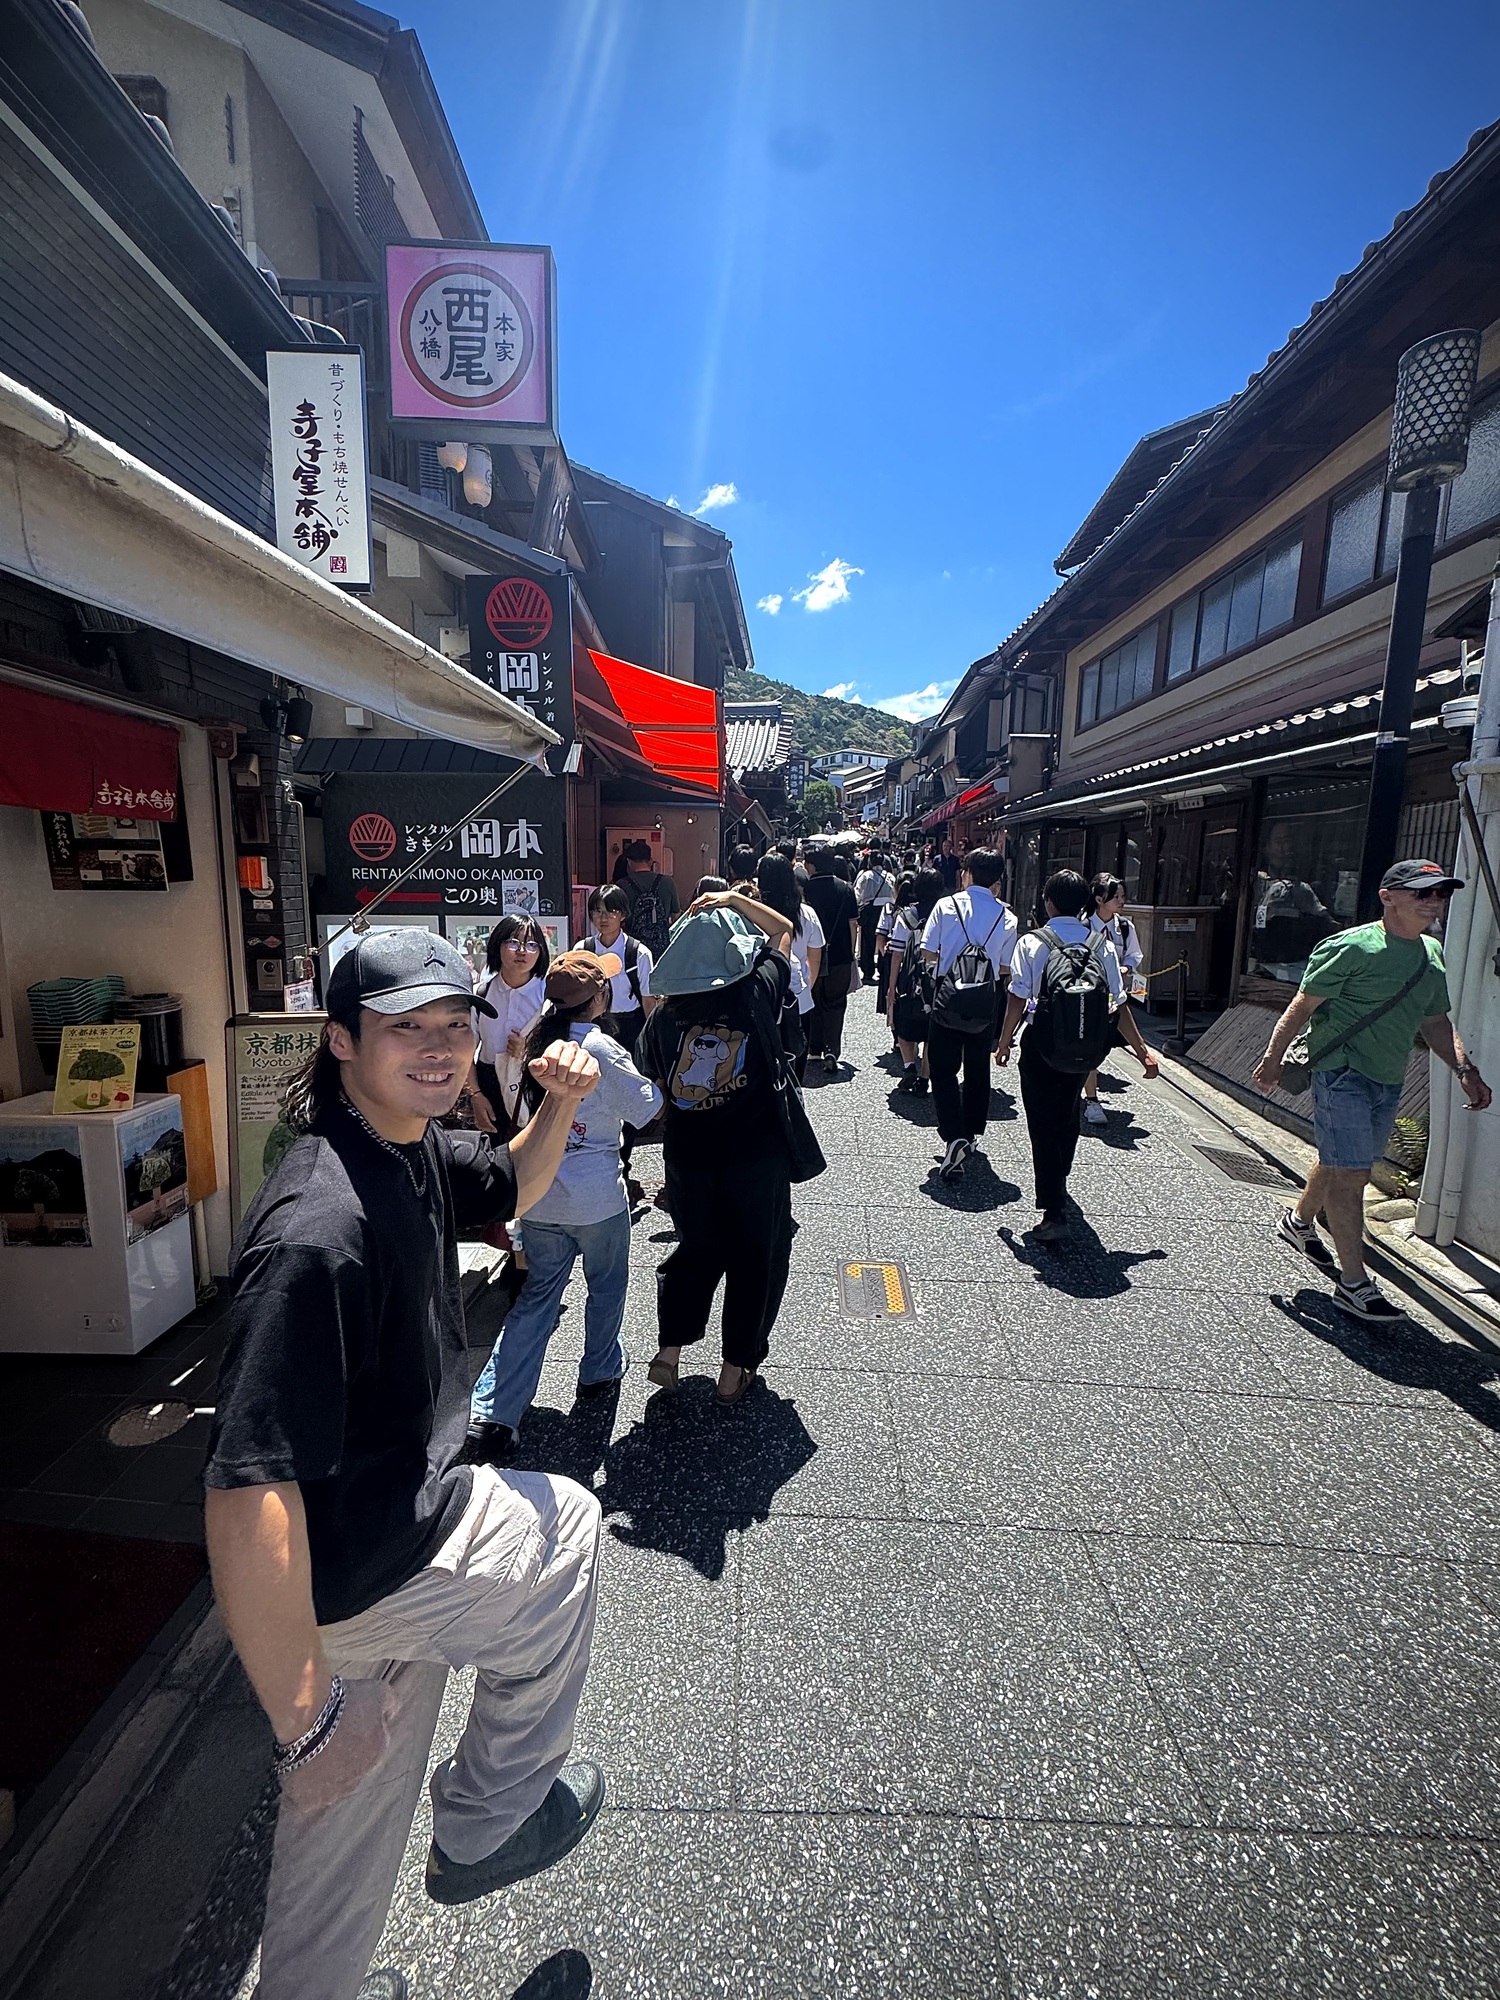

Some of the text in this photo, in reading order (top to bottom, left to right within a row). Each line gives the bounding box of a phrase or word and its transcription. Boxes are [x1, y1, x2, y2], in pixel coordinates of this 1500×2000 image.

[441, 287, 494, 386] 西尾
[494, 312, 516, 361] 本家
[328, 363, 350, 526] 昔づくり・もち焼せんべい
[288, 398, 338, 562] 寺子屋本舗
[542, 652, 555, 731] レンタル着
[97, 779, 176, 812] 寺子屋本舗
[405, 824, 452, 836] レンタル
[406, 836, 453, 852] きもの
[461, 819, 543, 858] 岡本
[352, 868, 402, 880] RENTAL
[471, 868, 544, 880] OKAMOTO
[445, 886, 498, 905] この奥
[68, 1027, 135, 1037] 京都抹茶アイス
[245, 1032, 318, 1055] 京都抹
[252, 1057, 292, 1069] Kyoto
